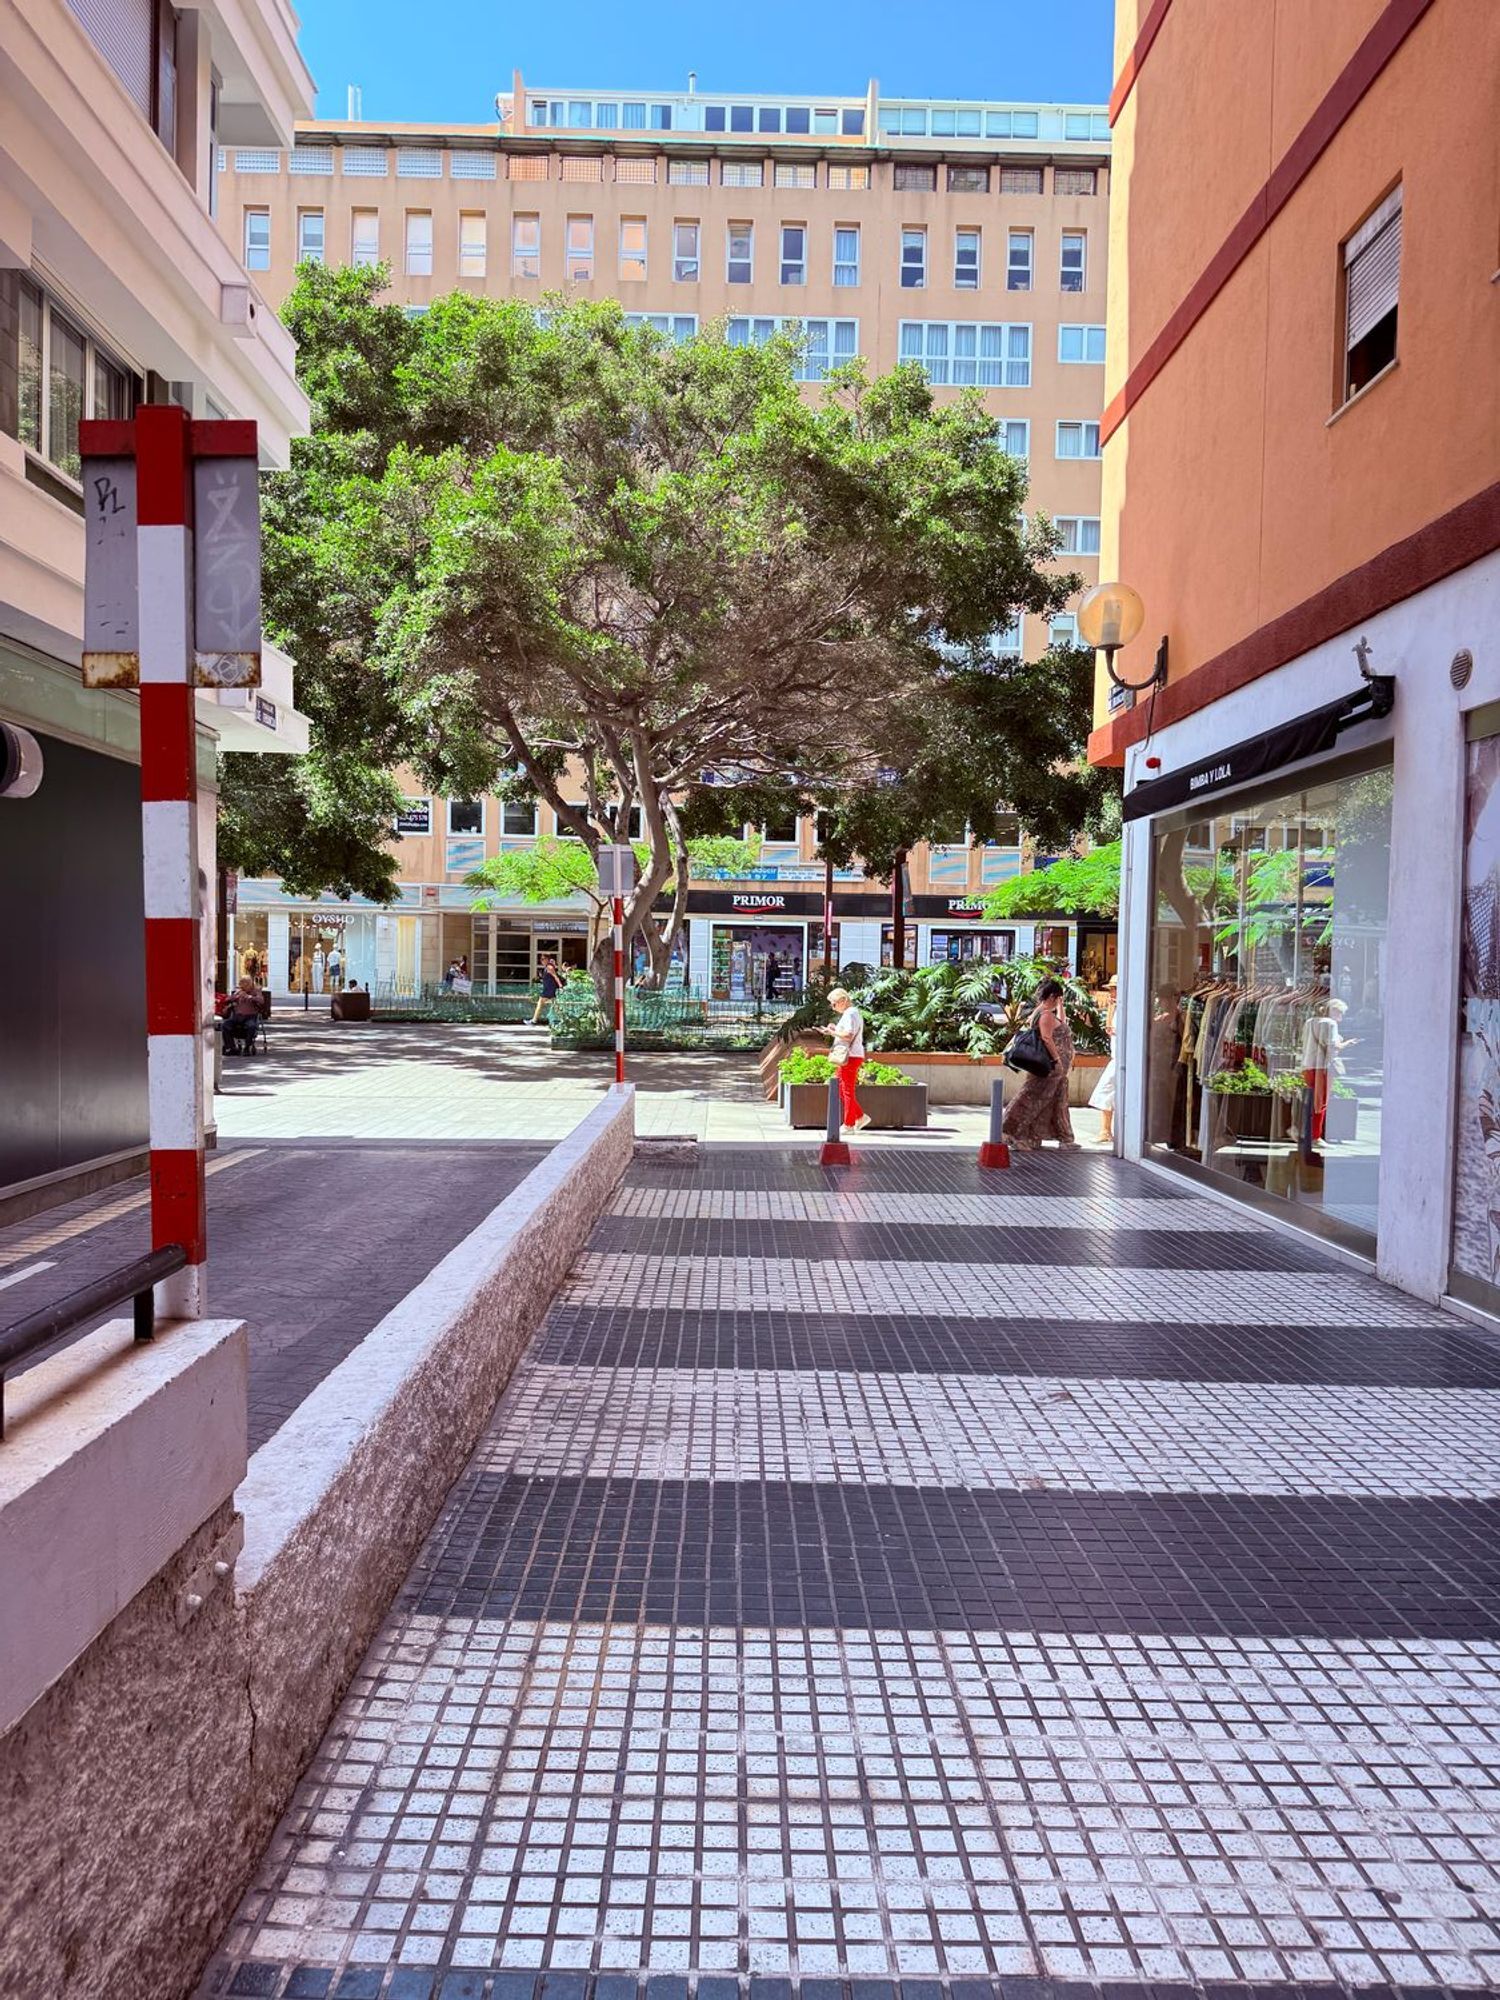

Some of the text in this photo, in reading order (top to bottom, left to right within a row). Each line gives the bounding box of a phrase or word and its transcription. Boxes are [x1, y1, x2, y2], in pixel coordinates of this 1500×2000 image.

[732, 895, 786, 907] PRIMOR
[947, 899, 994, 911] PRIMO
[312, 914, 355, 924] OYSHO
